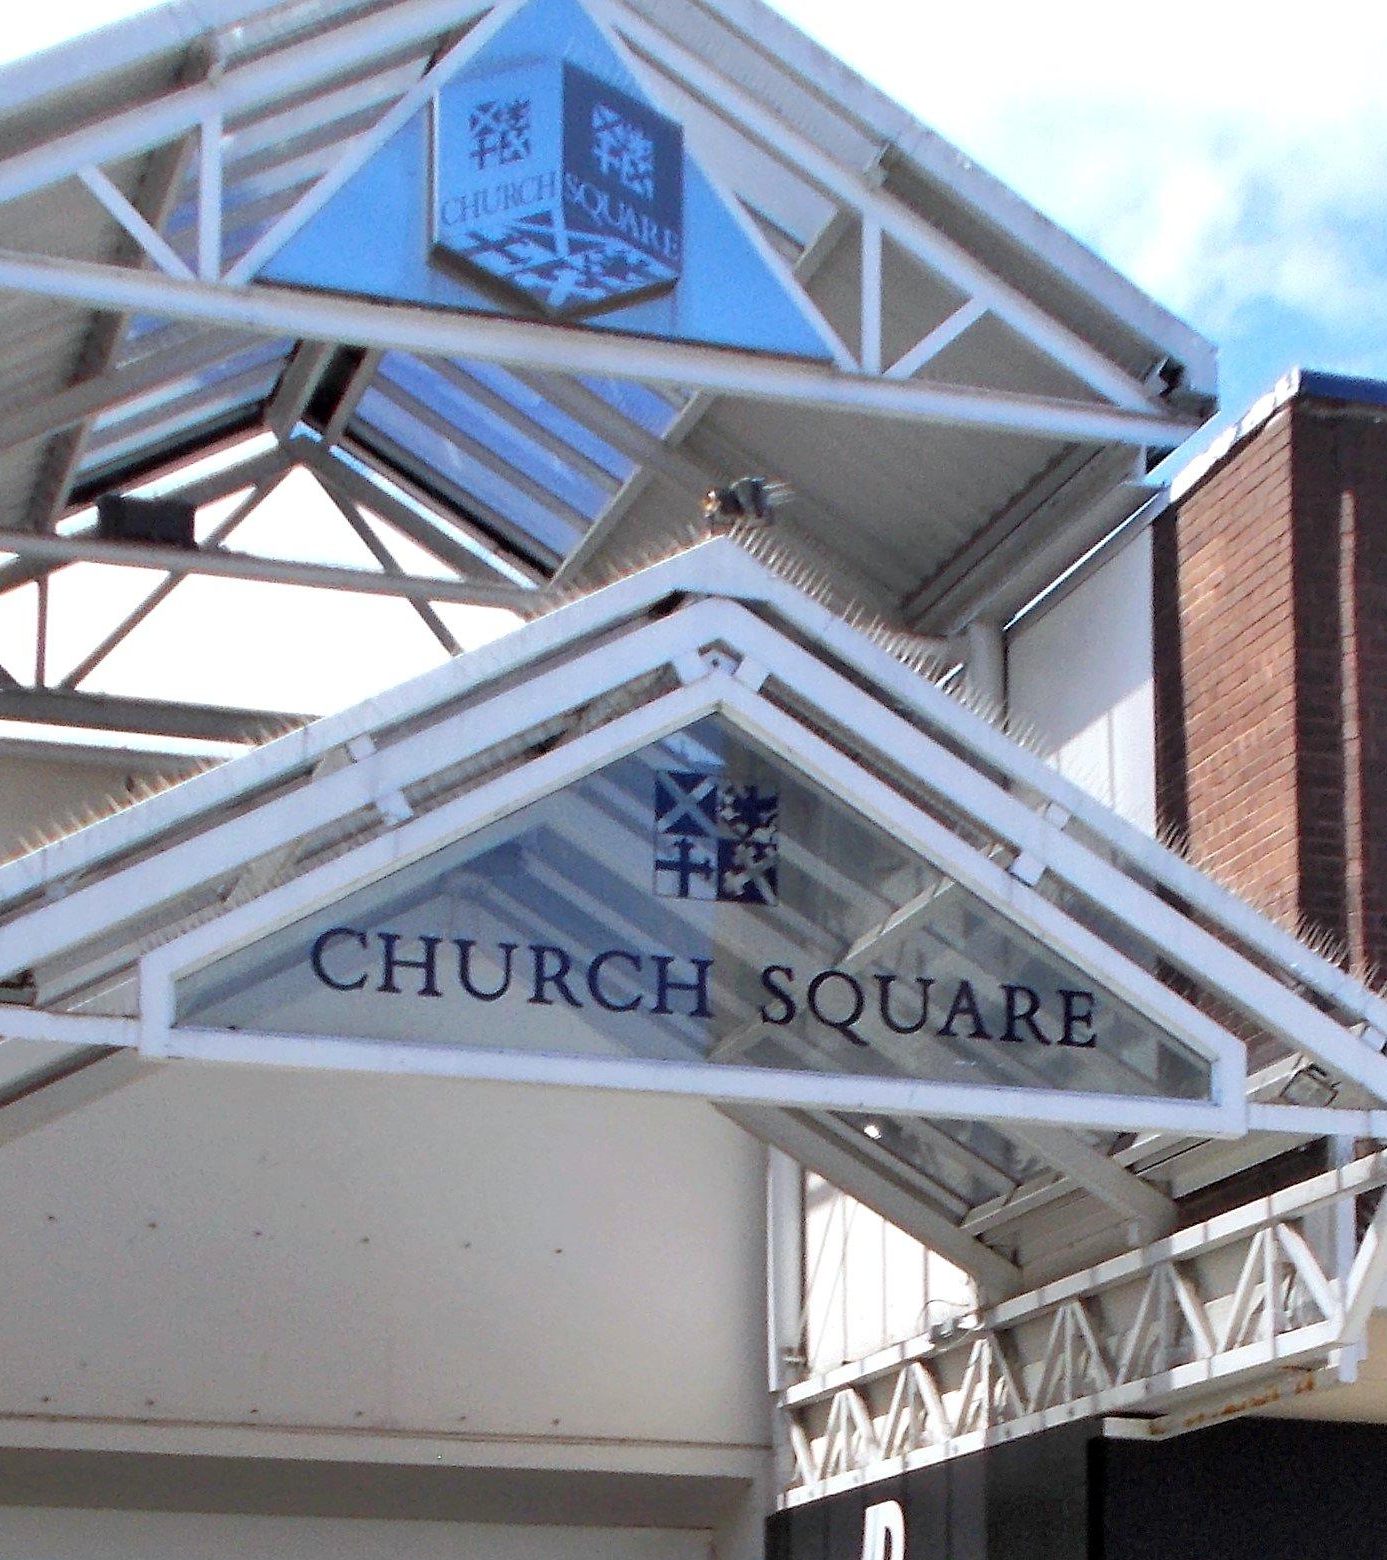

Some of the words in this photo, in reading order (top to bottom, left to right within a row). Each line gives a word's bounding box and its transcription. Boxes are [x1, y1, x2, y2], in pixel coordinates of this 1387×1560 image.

[440, 171, 557, 228] CHURCH
[564, 172, 680, 260] SQUARE
[311, 926, 715, 1020] CHURCH
[759, 965, 1099, 1049] SQUARE
